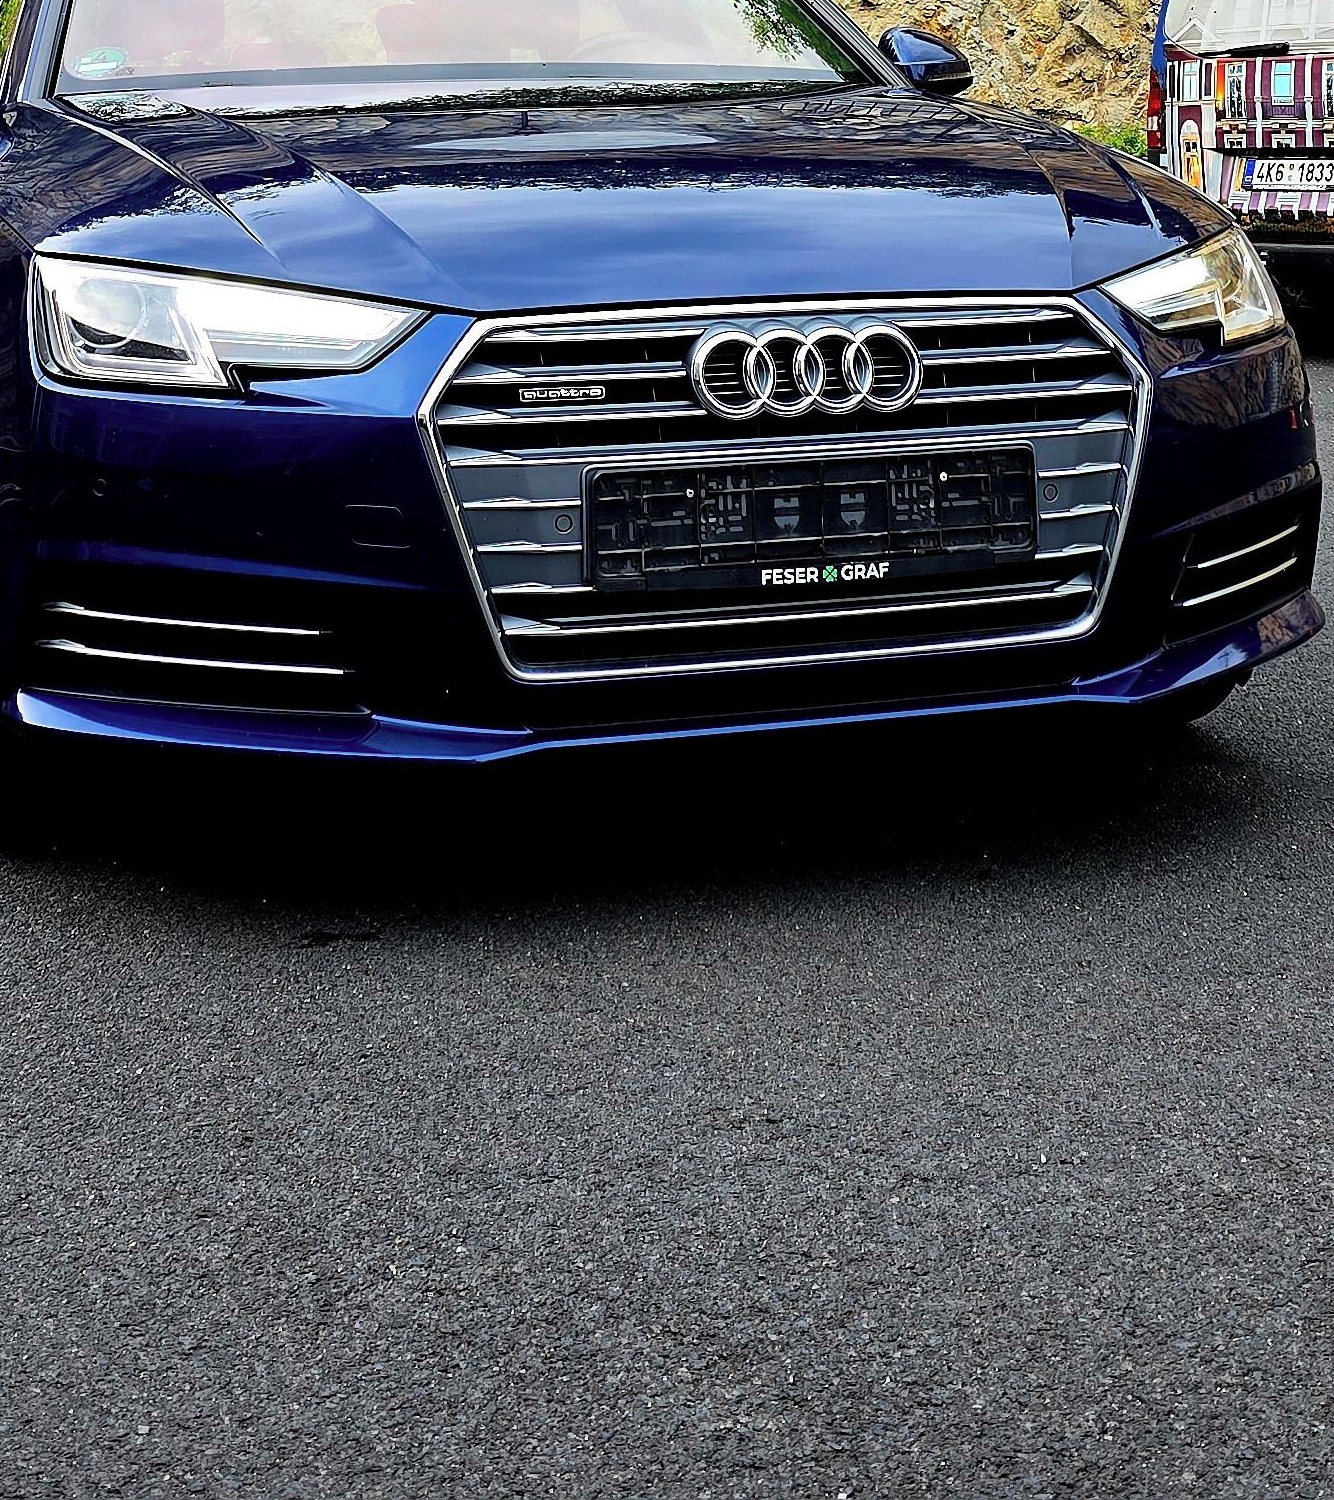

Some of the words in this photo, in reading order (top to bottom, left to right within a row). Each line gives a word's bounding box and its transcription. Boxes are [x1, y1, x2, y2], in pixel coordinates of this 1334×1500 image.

[1257, 162, 1284, 182] 4K6
[1298, 162, 1334, 182] 1833
[523, 388, 602, 400] quattro
[761, 567, 819, 585] FESER
[840, 561, 890, 581] GRAF
